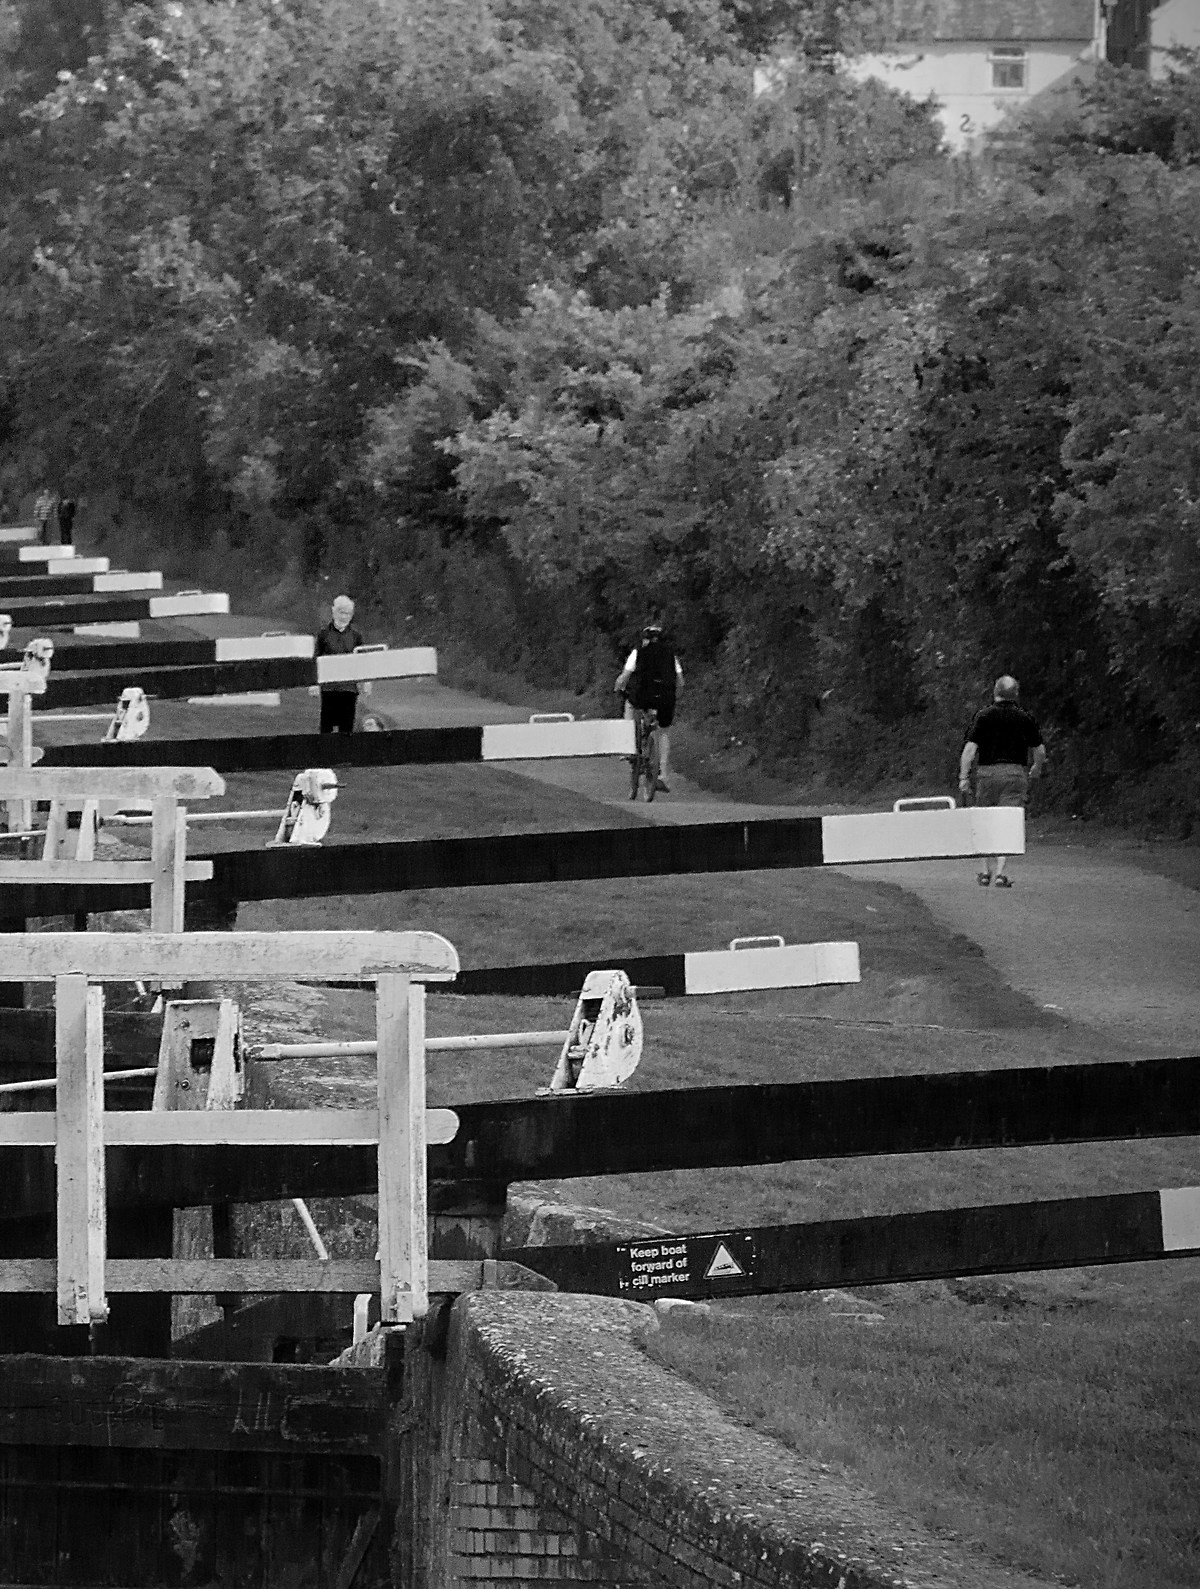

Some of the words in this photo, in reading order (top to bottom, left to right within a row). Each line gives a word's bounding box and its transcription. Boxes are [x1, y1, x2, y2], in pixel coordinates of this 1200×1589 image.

[630, 1247, 659, 1259] Keep
[661, 1244, 687, 1256] boat
[630, 1258, 673, 1273] forward
[675, 1257, 688, 1268] of
[632, 1274, 649, 1286] cill
[650, 1272, 690, 1285] marker
